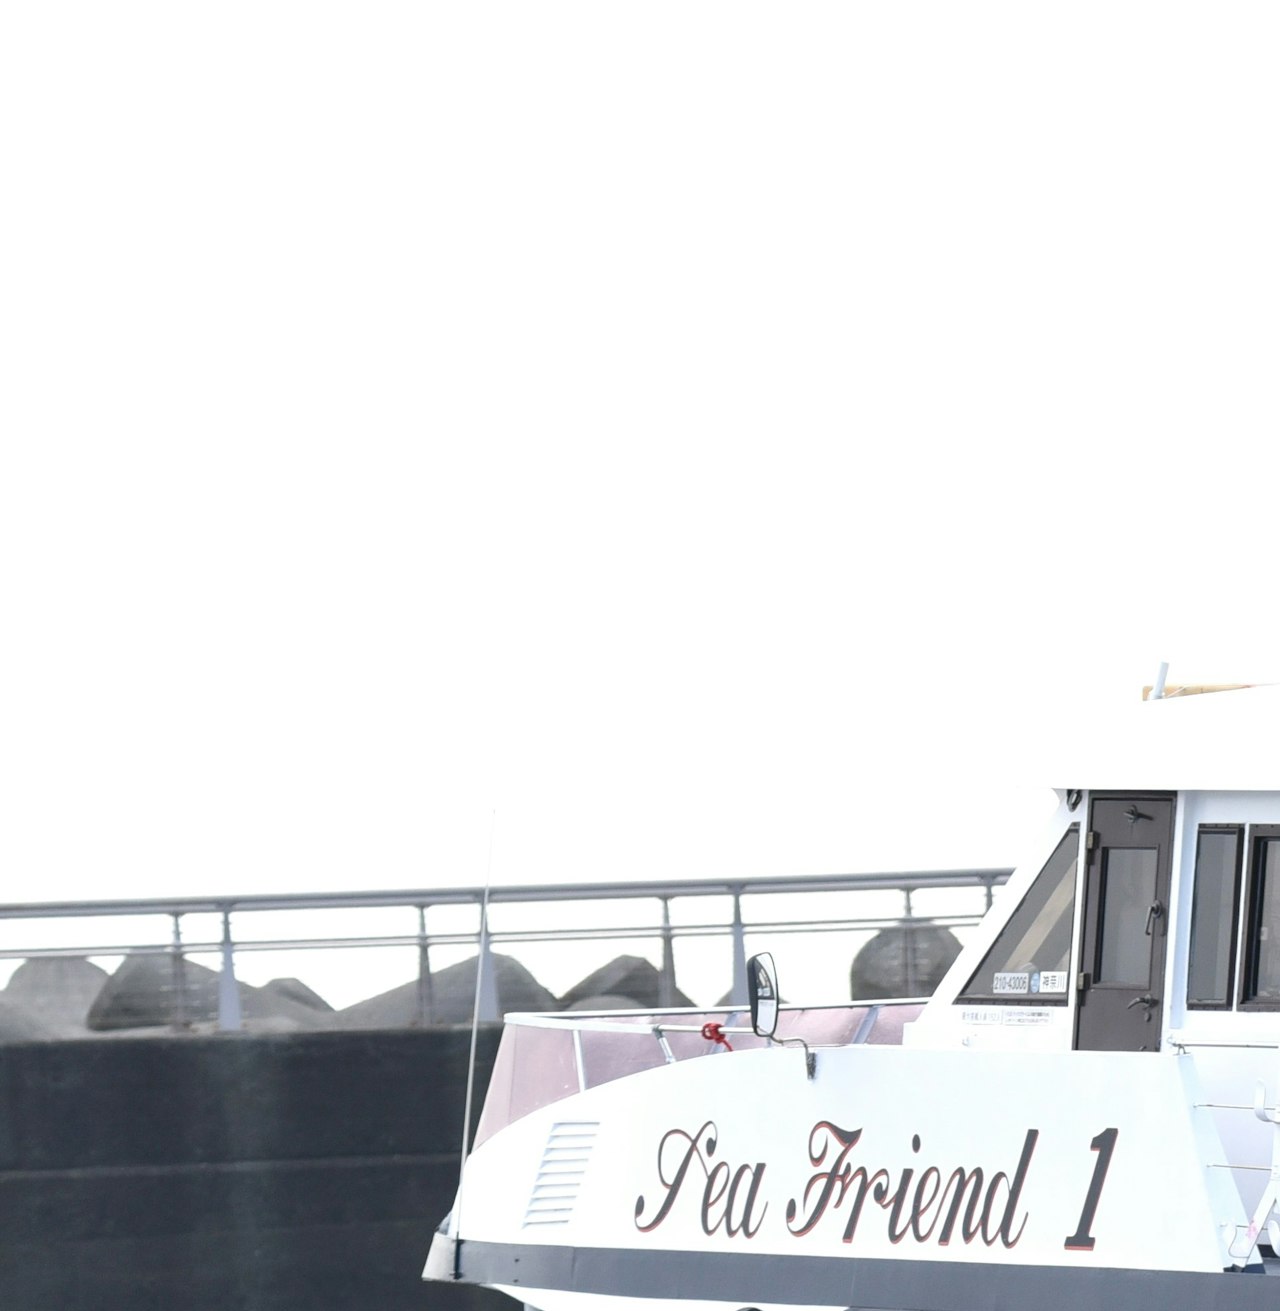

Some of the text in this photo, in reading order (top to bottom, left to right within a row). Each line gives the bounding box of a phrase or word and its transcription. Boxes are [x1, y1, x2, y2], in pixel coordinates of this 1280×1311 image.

[1042, 975, 1065, 990] 神奈川
[635, 1121, 1118, 1251] Sea Friend 1
